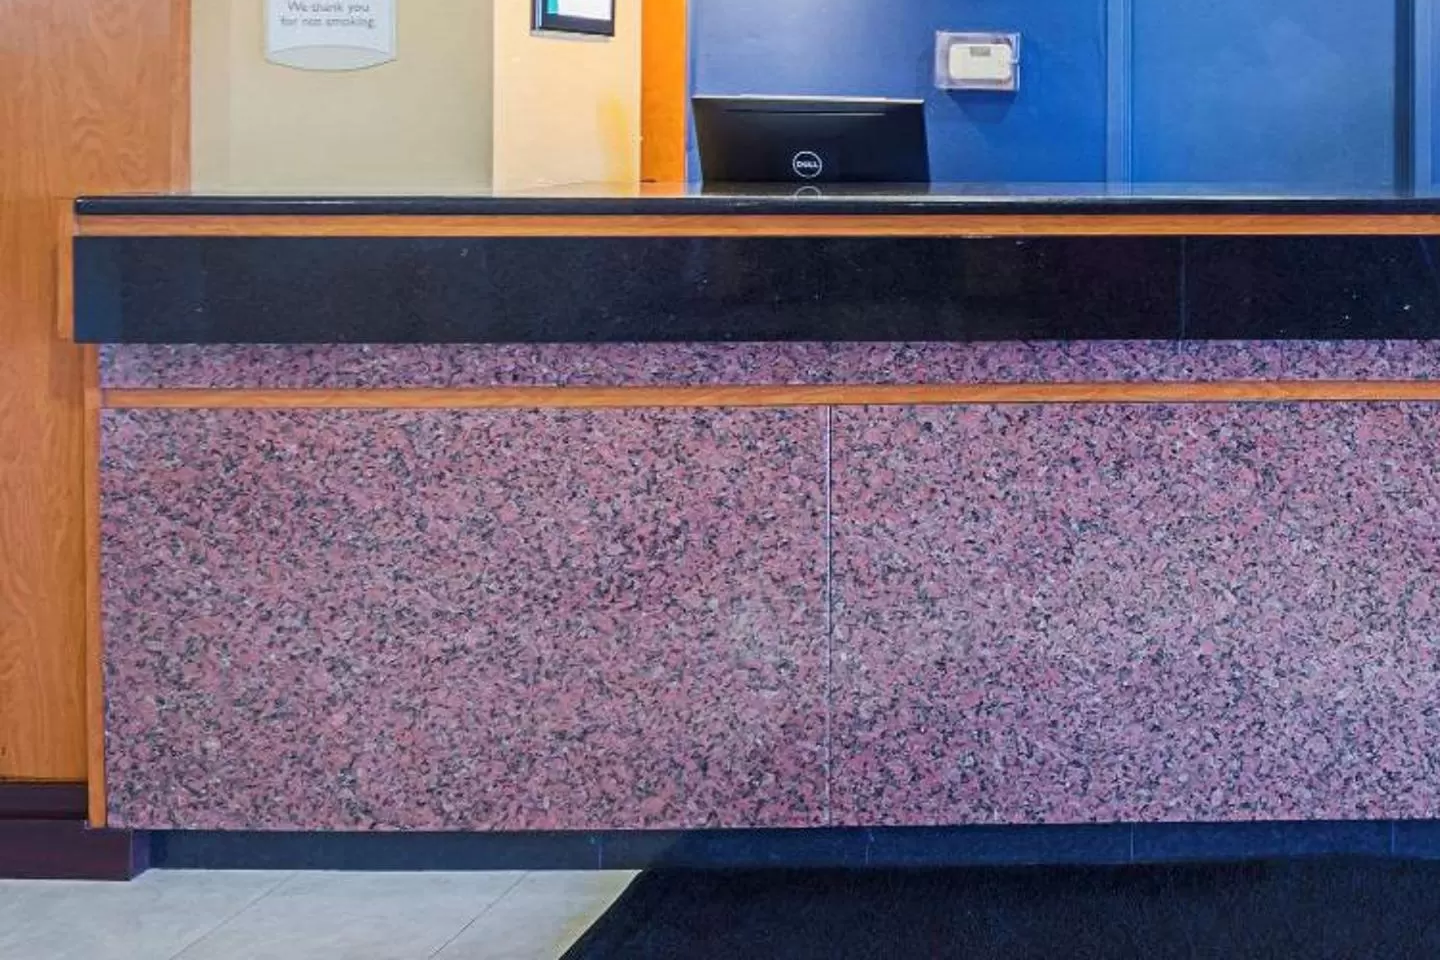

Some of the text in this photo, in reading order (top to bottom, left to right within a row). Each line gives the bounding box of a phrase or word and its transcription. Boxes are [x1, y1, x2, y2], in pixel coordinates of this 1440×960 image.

[287, 0, 370, 15] We thank you
[280, 16, 297, 26] for
[302, 17, 321, 26] not
